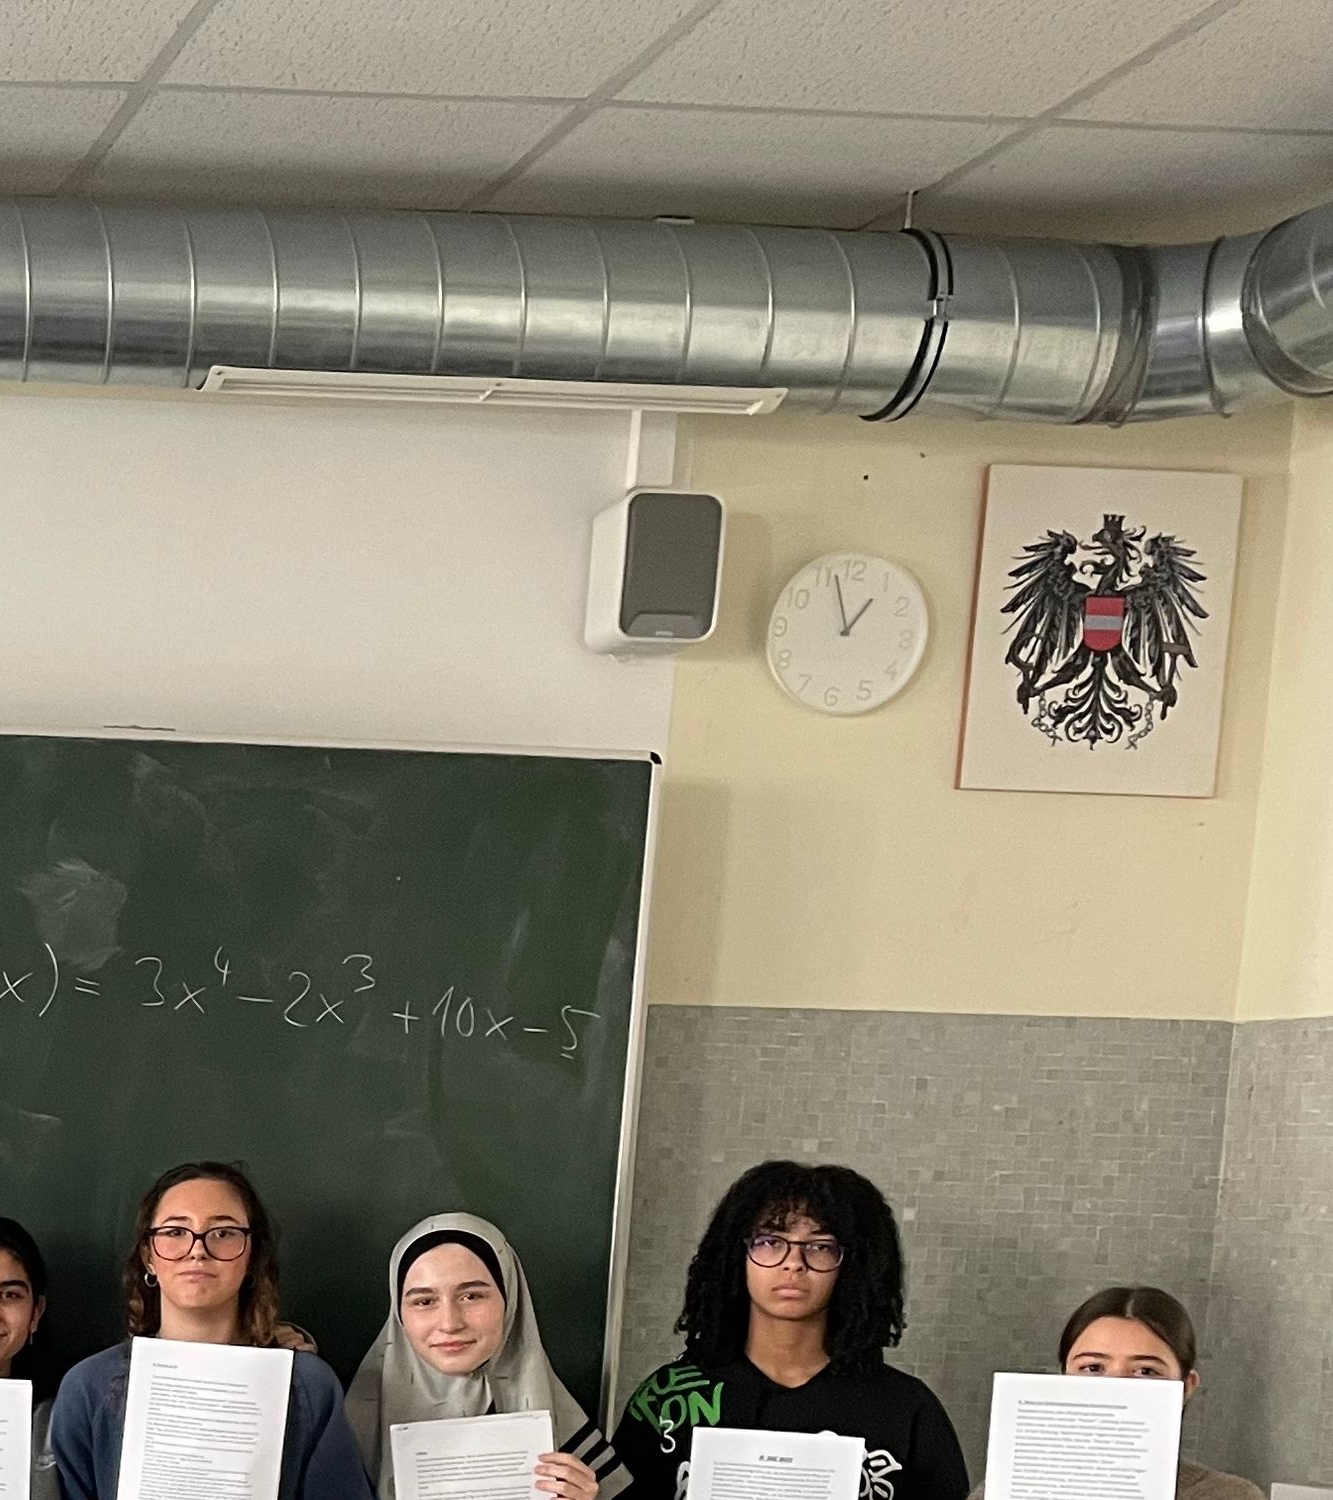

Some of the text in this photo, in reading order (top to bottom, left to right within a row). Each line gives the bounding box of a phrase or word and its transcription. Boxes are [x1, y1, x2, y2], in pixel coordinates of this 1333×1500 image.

[844, 560, 867, 582] 12
[786, 587, 810, 610] 10
[893, 596, 910, 618] 2
[773, 616, 788, 637] 9
[778, 649, 792, 670] 8
[823, 686, 842, 707] 6
[856, 679, 873, 701] 5
